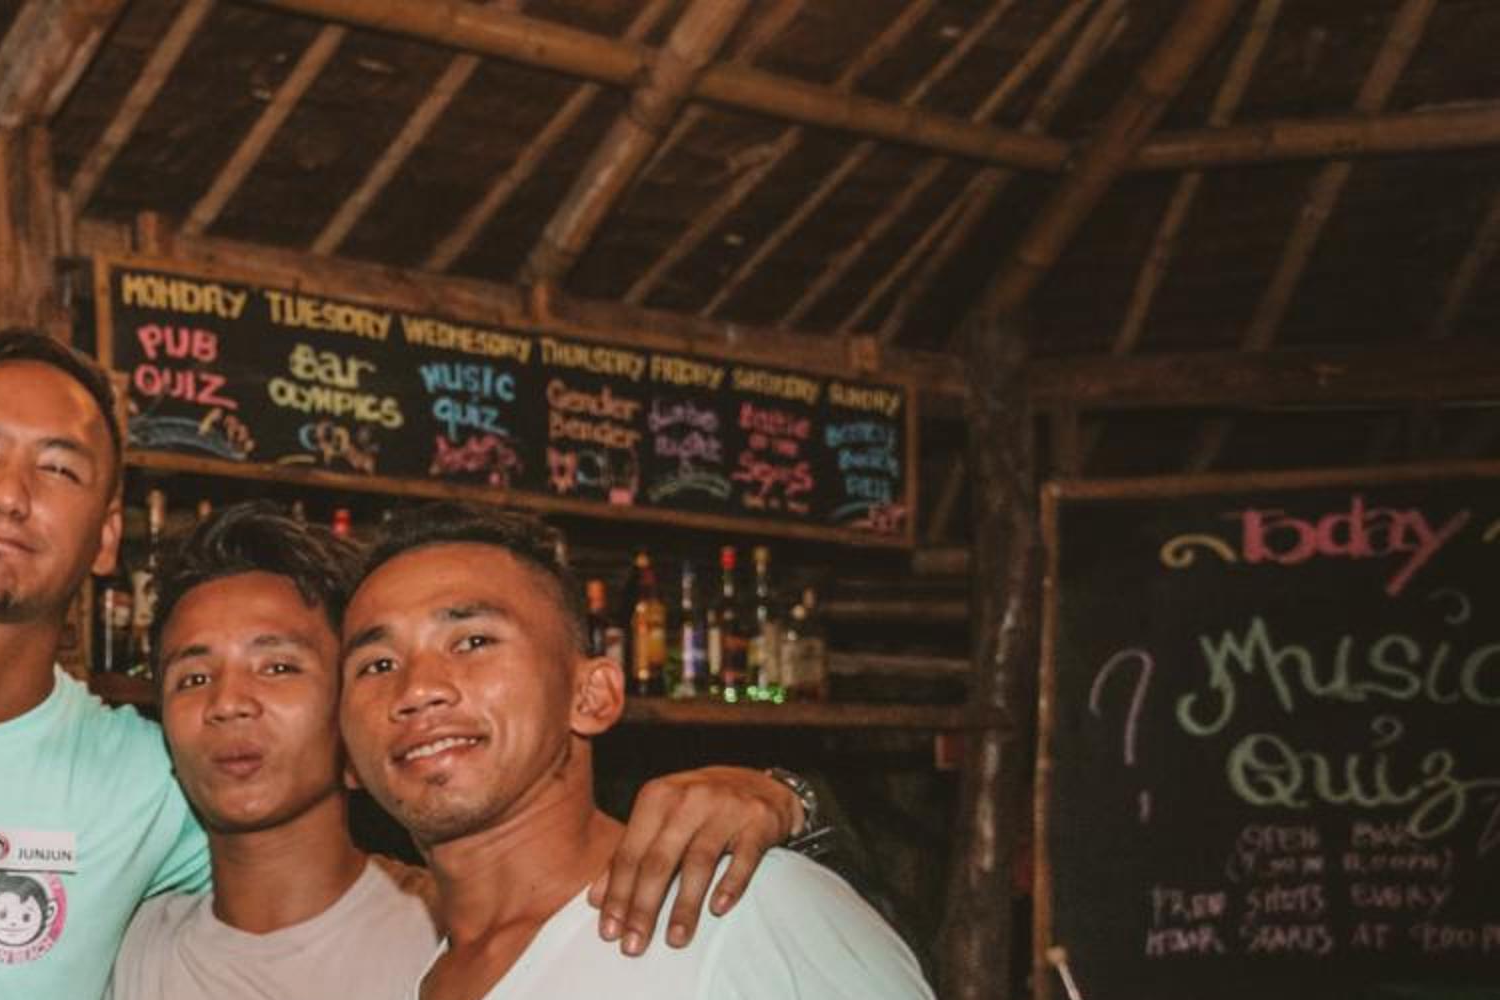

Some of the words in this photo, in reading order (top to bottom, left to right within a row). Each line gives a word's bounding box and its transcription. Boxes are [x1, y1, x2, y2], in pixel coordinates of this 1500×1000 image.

[121, 273, 248, 320] MONDAY
[264, 289, 392, 340] TUESDAY
[136, 323, 218, 363] PUB
[134, 363, 238, 410] QUIZ
[419, 362, 517, 402] MUSIC
[1220, 493, 1471, 597] Today
[1176, 590, 1500, 737] Music
[1226, 715, 1500, 840] Quiz
[17, 847, 73, 862] JUNJUN
